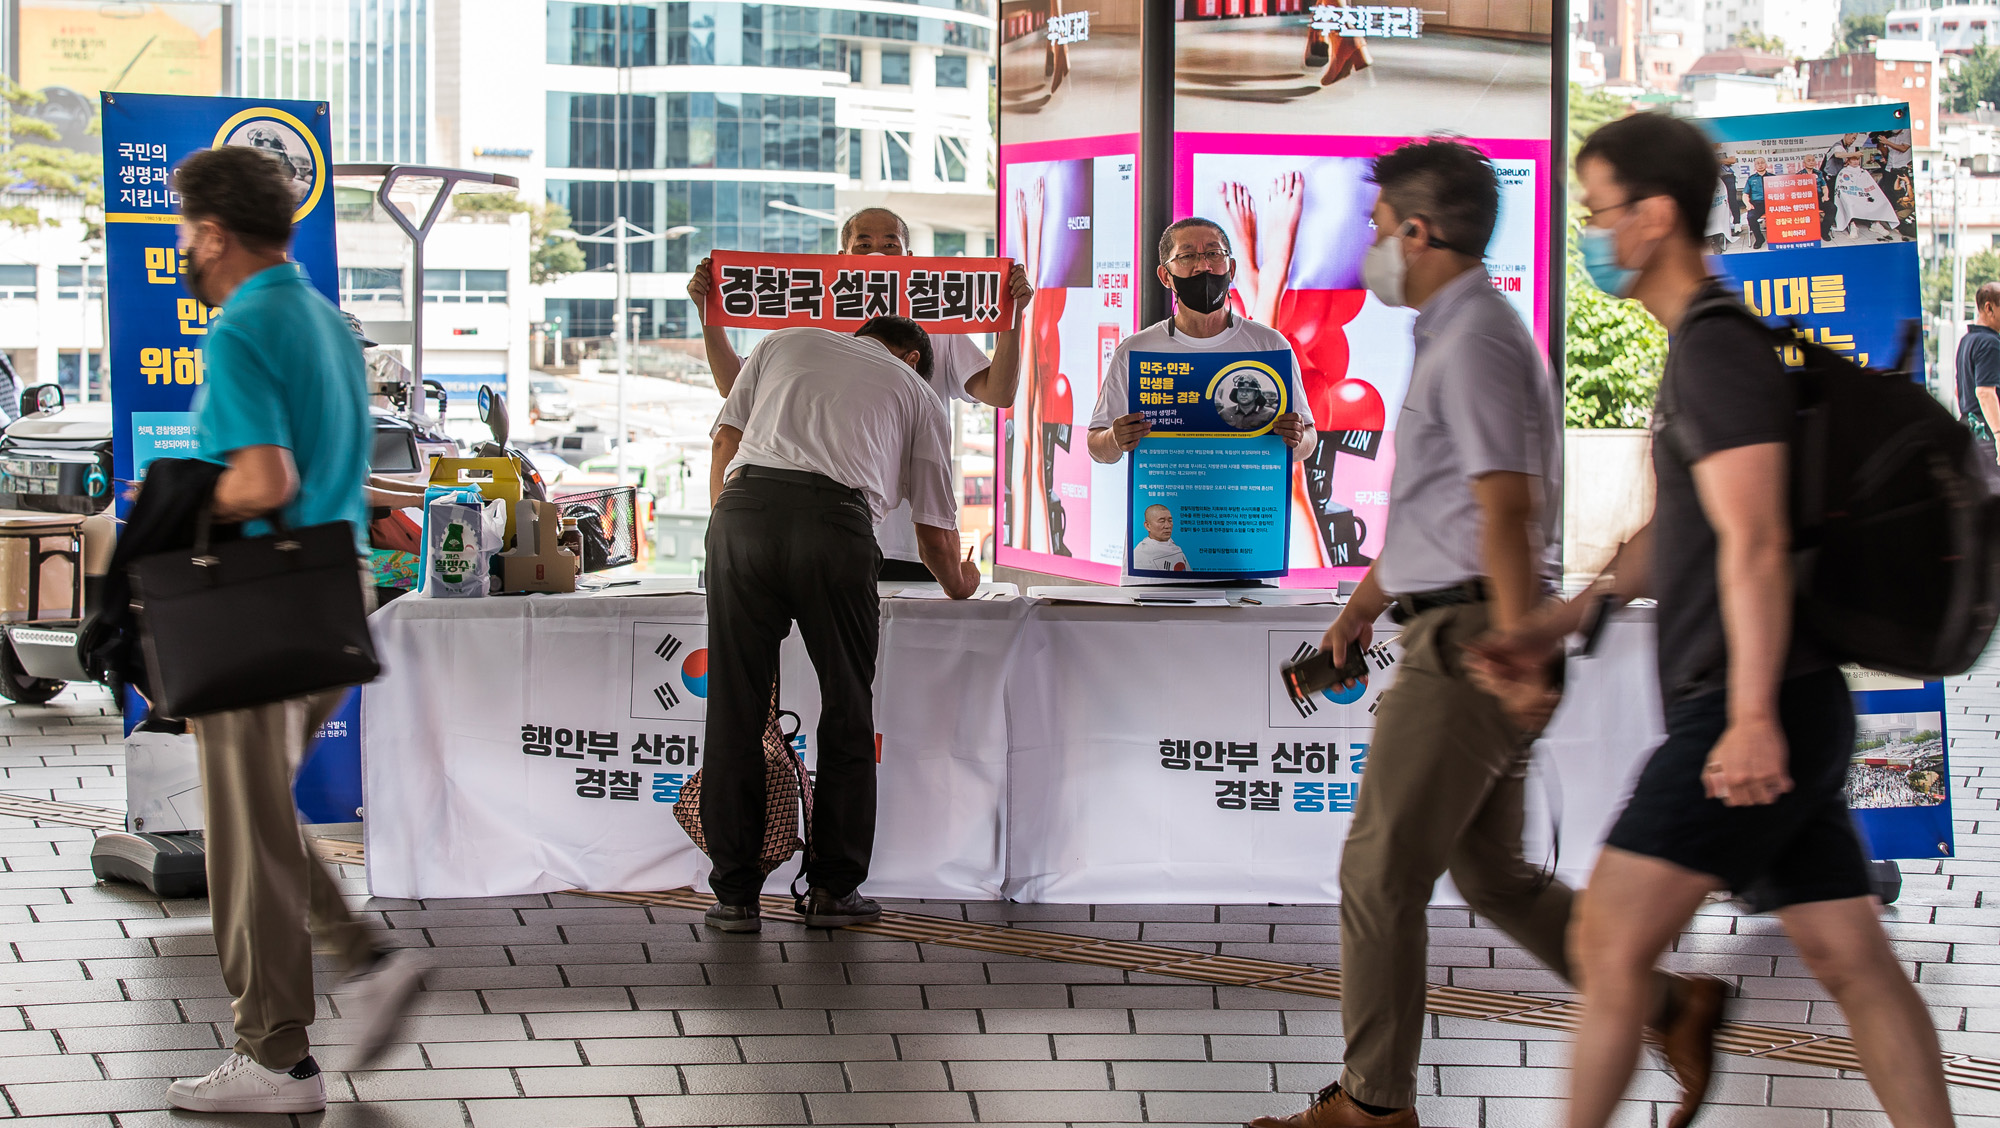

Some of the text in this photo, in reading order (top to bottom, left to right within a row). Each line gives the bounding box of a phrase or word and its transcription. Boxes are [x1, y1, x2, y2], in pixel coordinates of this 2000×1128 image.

[118, 143, 167, 162] 국민의
[119, 165, 169, 185] 생명과
[1797, 178, 1814, 186] 경찰의
[1768, 191, 1813, 201] 독립성 중립성을
[1769, 203, 1816, 213] 무시하는 행안부의
[1775, 216, 1811, 226] 경찰국 신설을
[1781, 229, 1807, 238] 철회하라!
[1098, 273, 1129, 289] 아픈 다리에
[720, 265, 1002, 323] 경찰국 설치 철회!!
[1139, 361, 1195, 375] 민주·인권·
[1139, 377, 1174, 390] 민생을
[1139, 391, 1201, 405] 위하는 경찰
[1159, 409, 1177, 417] 생명과
[1158, 418, 1185, 426] 지킵니다.
[138, 425, 154, 436] 첫째,
[155, 425, 191, 436] 경찰청장의
[154, 439, 190, 450] 보장되어야
[1354, 490, 1390, 507] 무거운
[434, 560, 470, 572] 활명수
[326, 720, 348, 730] 삭발식
[521, 724, 700, 767] 행안부 산하
[1159, 738, 1259, 773] 행안부
[1271, 742, 1340, 775] 산하
[575, 767, 701, 804] 경찰 중
[1215, 780, 1360, 813] 경찰 중립
